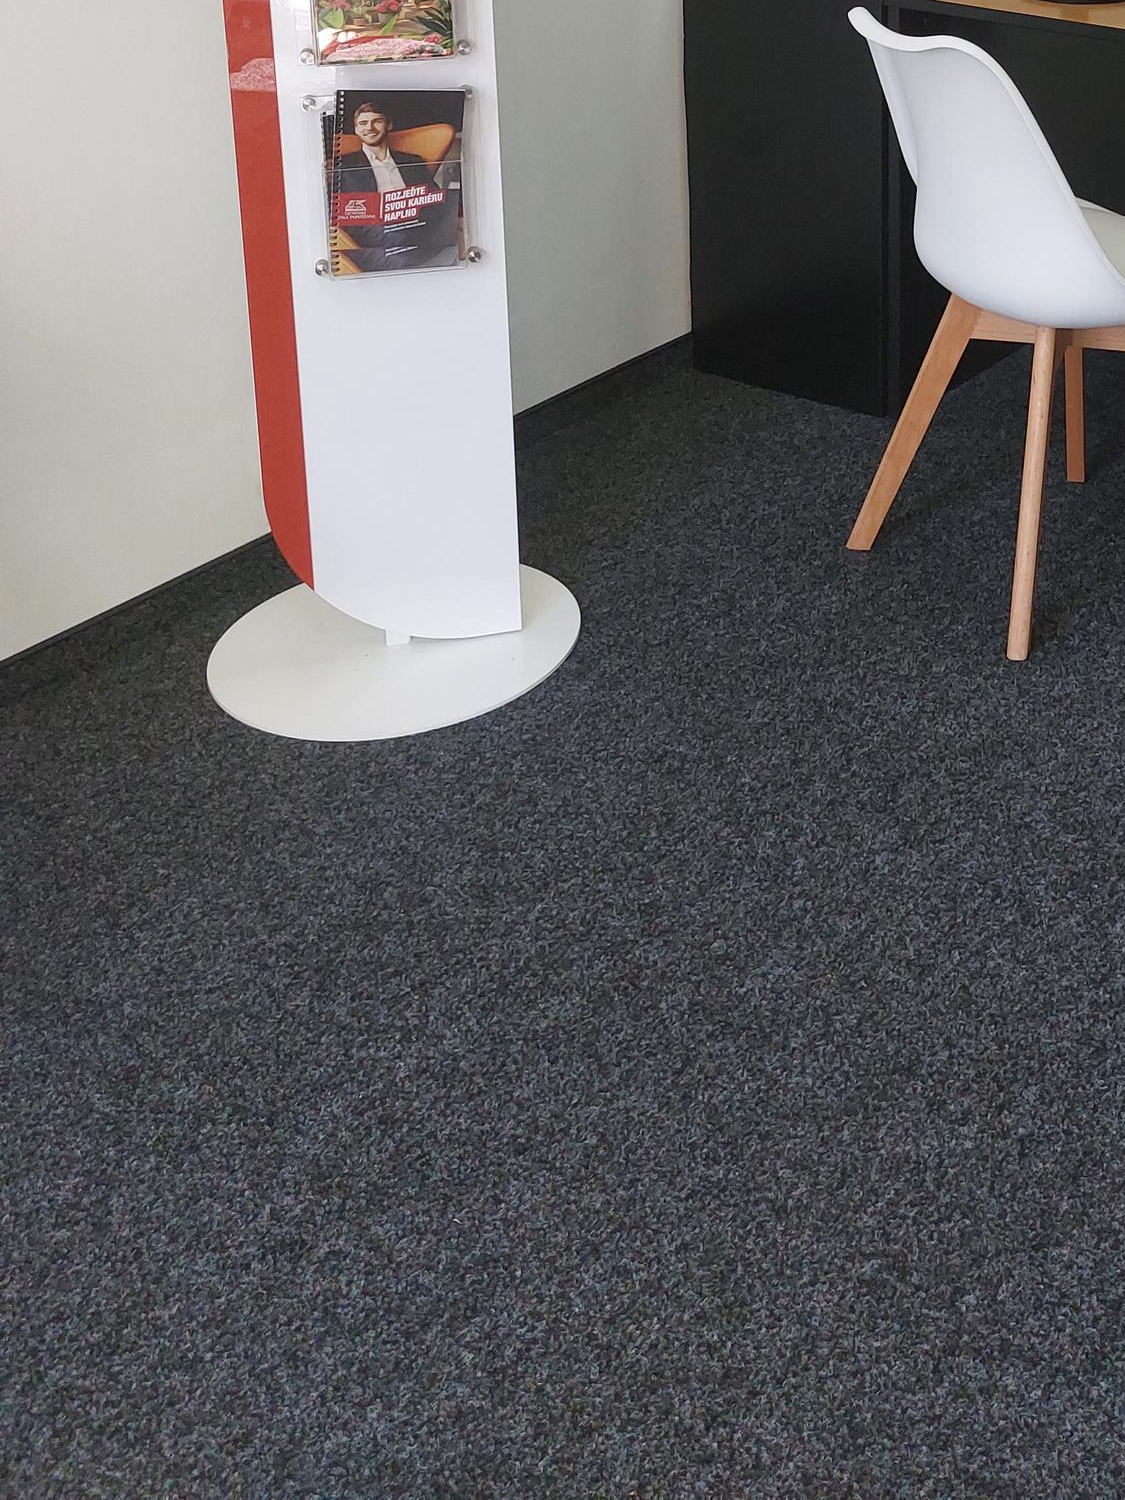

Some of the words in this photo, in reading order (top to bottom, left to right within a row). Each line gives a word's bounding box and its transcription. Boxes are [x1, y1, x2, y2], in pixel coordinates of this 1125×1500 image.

[384, 201, 406, 212] SVOU
[408, 192, 443, 207] KARIÉRU
[385, 186, 426, 203] ROZJEĎTE
[384, 208, 417, 222] NAPLNO
